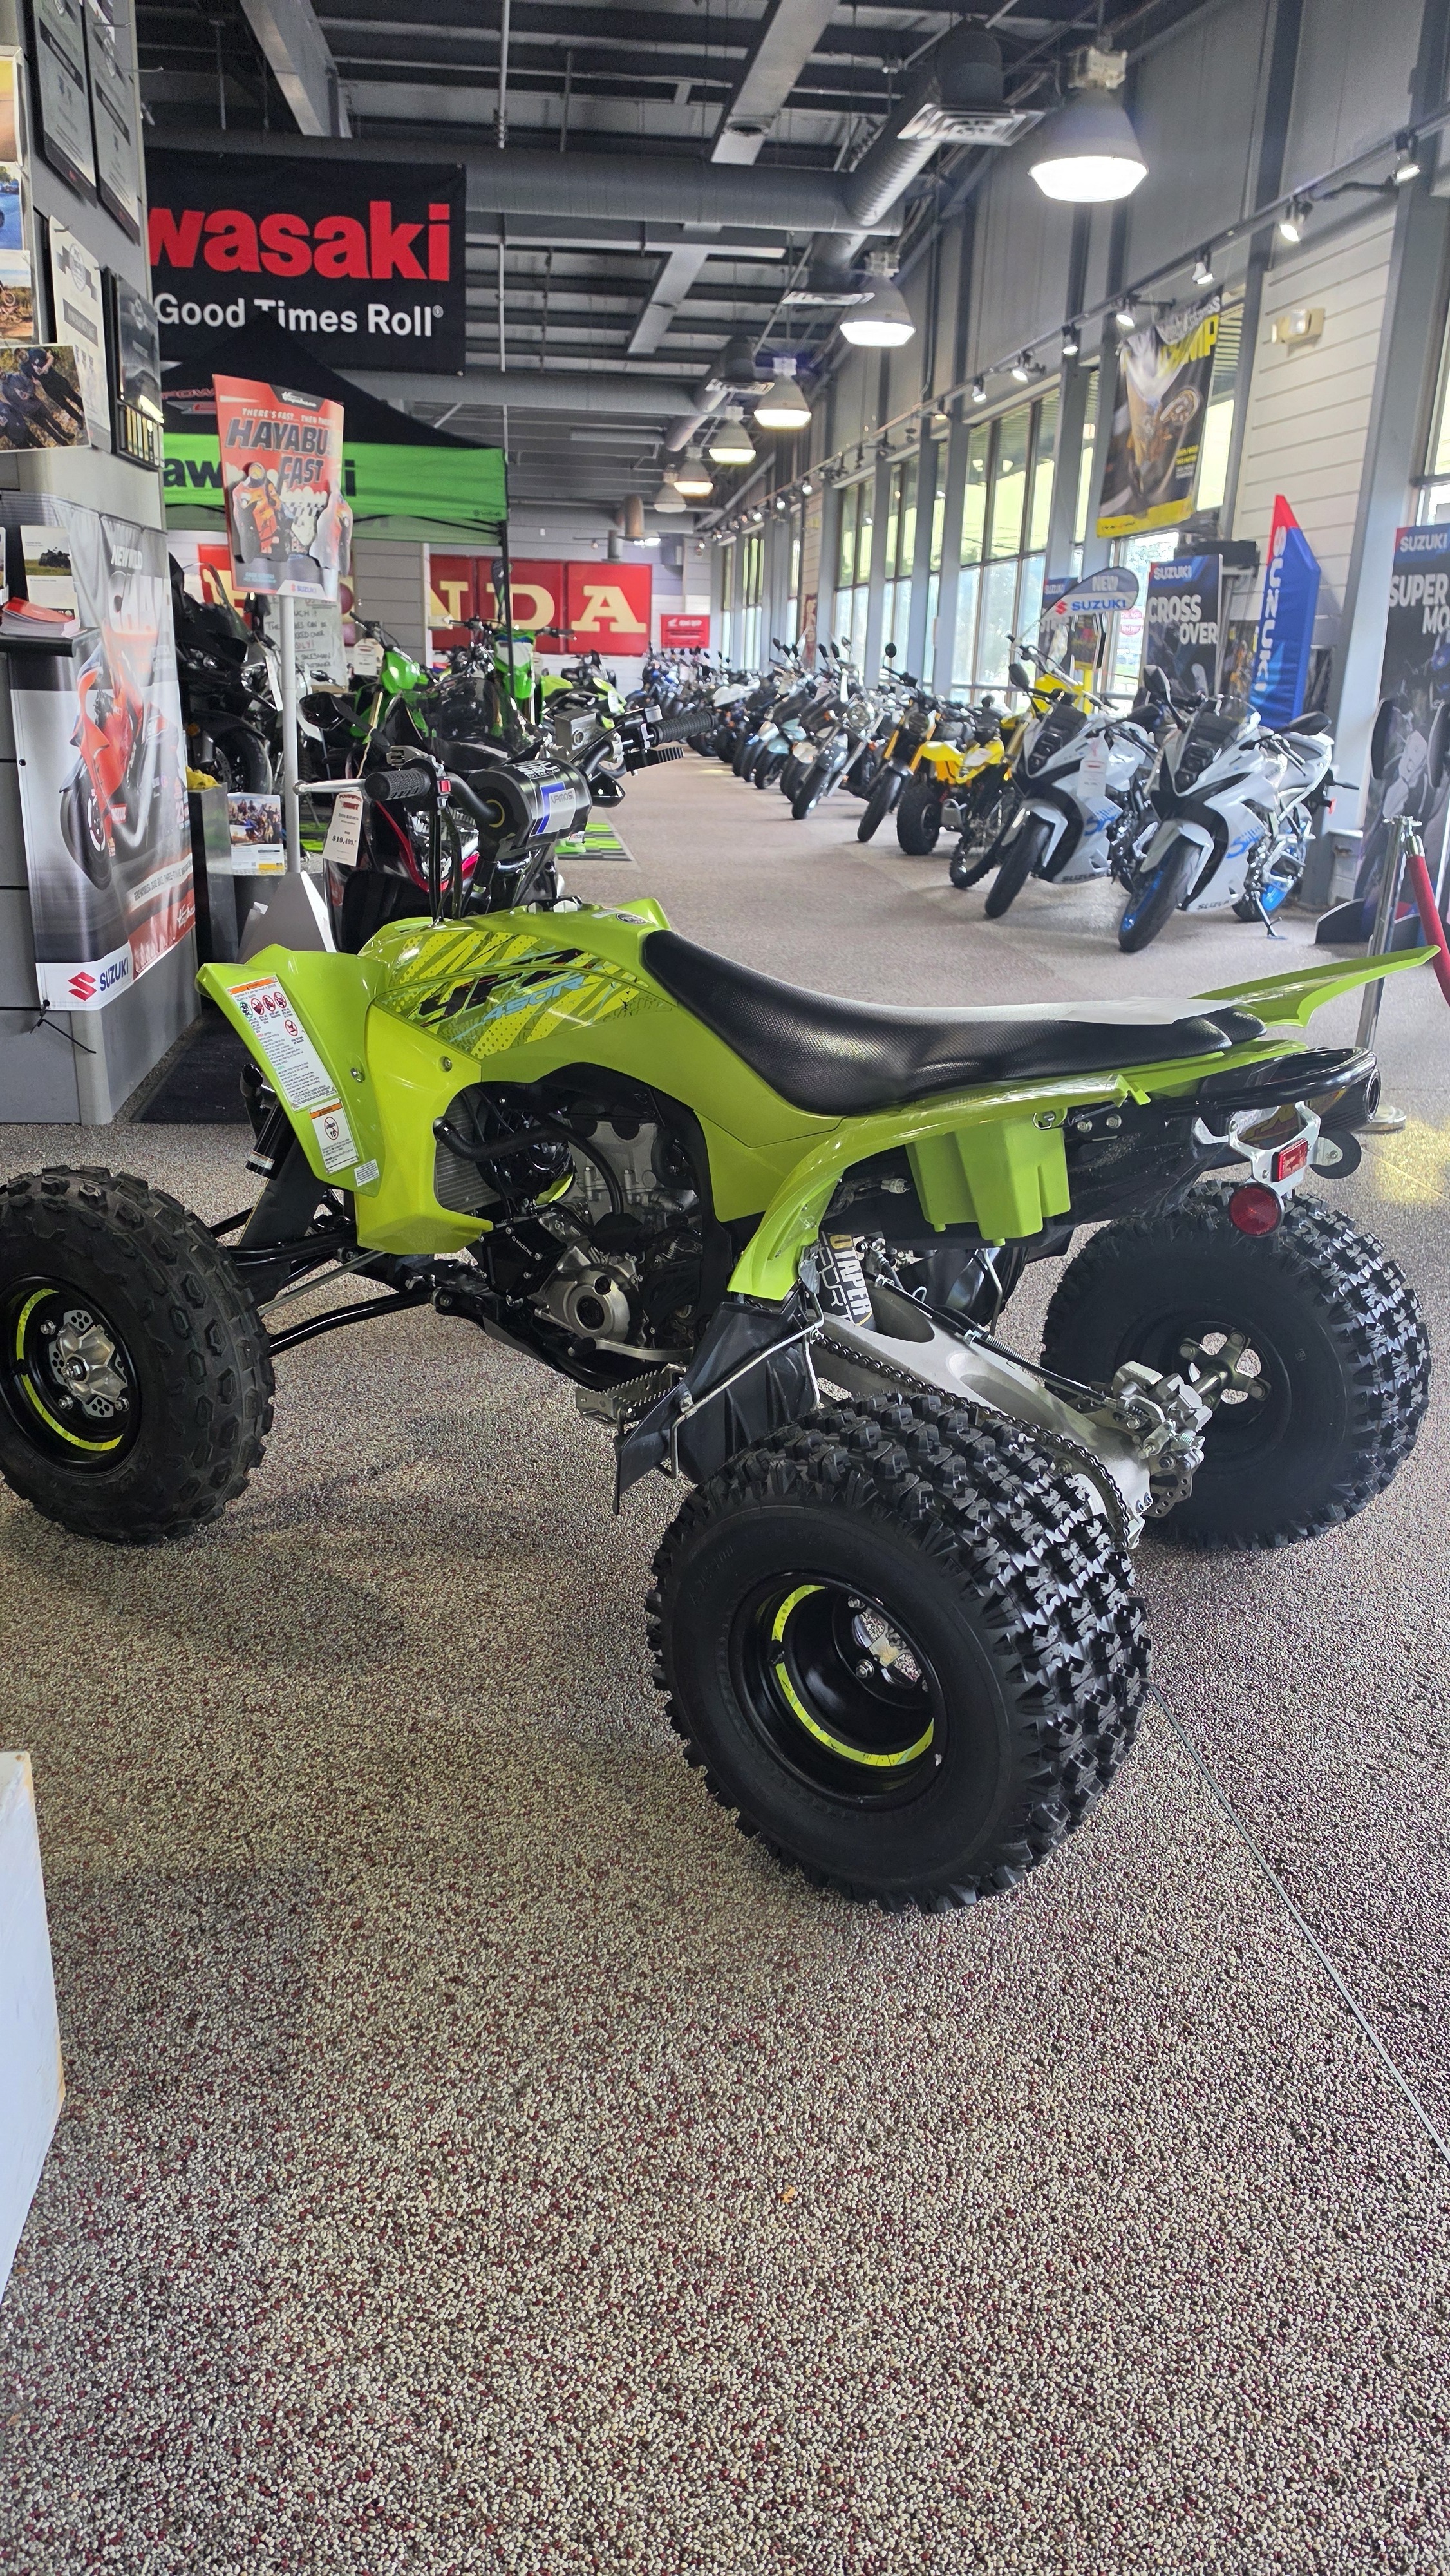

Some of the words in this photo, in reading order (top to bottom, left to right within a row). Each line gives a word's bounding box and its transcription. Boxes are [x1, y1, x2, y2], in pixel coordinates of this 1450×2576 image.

[153, 293, 245, 328] Good
[276, 454, 325, 494] FAST
[1399, 532, 1448, 553] SUZUKI
[1092, 575, 1119, 592] NEW
[1153, 565, 1192, 580] SUZUKI
[1071, 598, 1126, 611] SUZUKI
[1388, 573, 1449, 607] SUPER
[1147, 594, 1202, 623] CROSS
[1180, 621, 1219, 645] OVER
[99, 956, 129, 992] SUZUKI
[482, 972, 585, 1023] 450R
